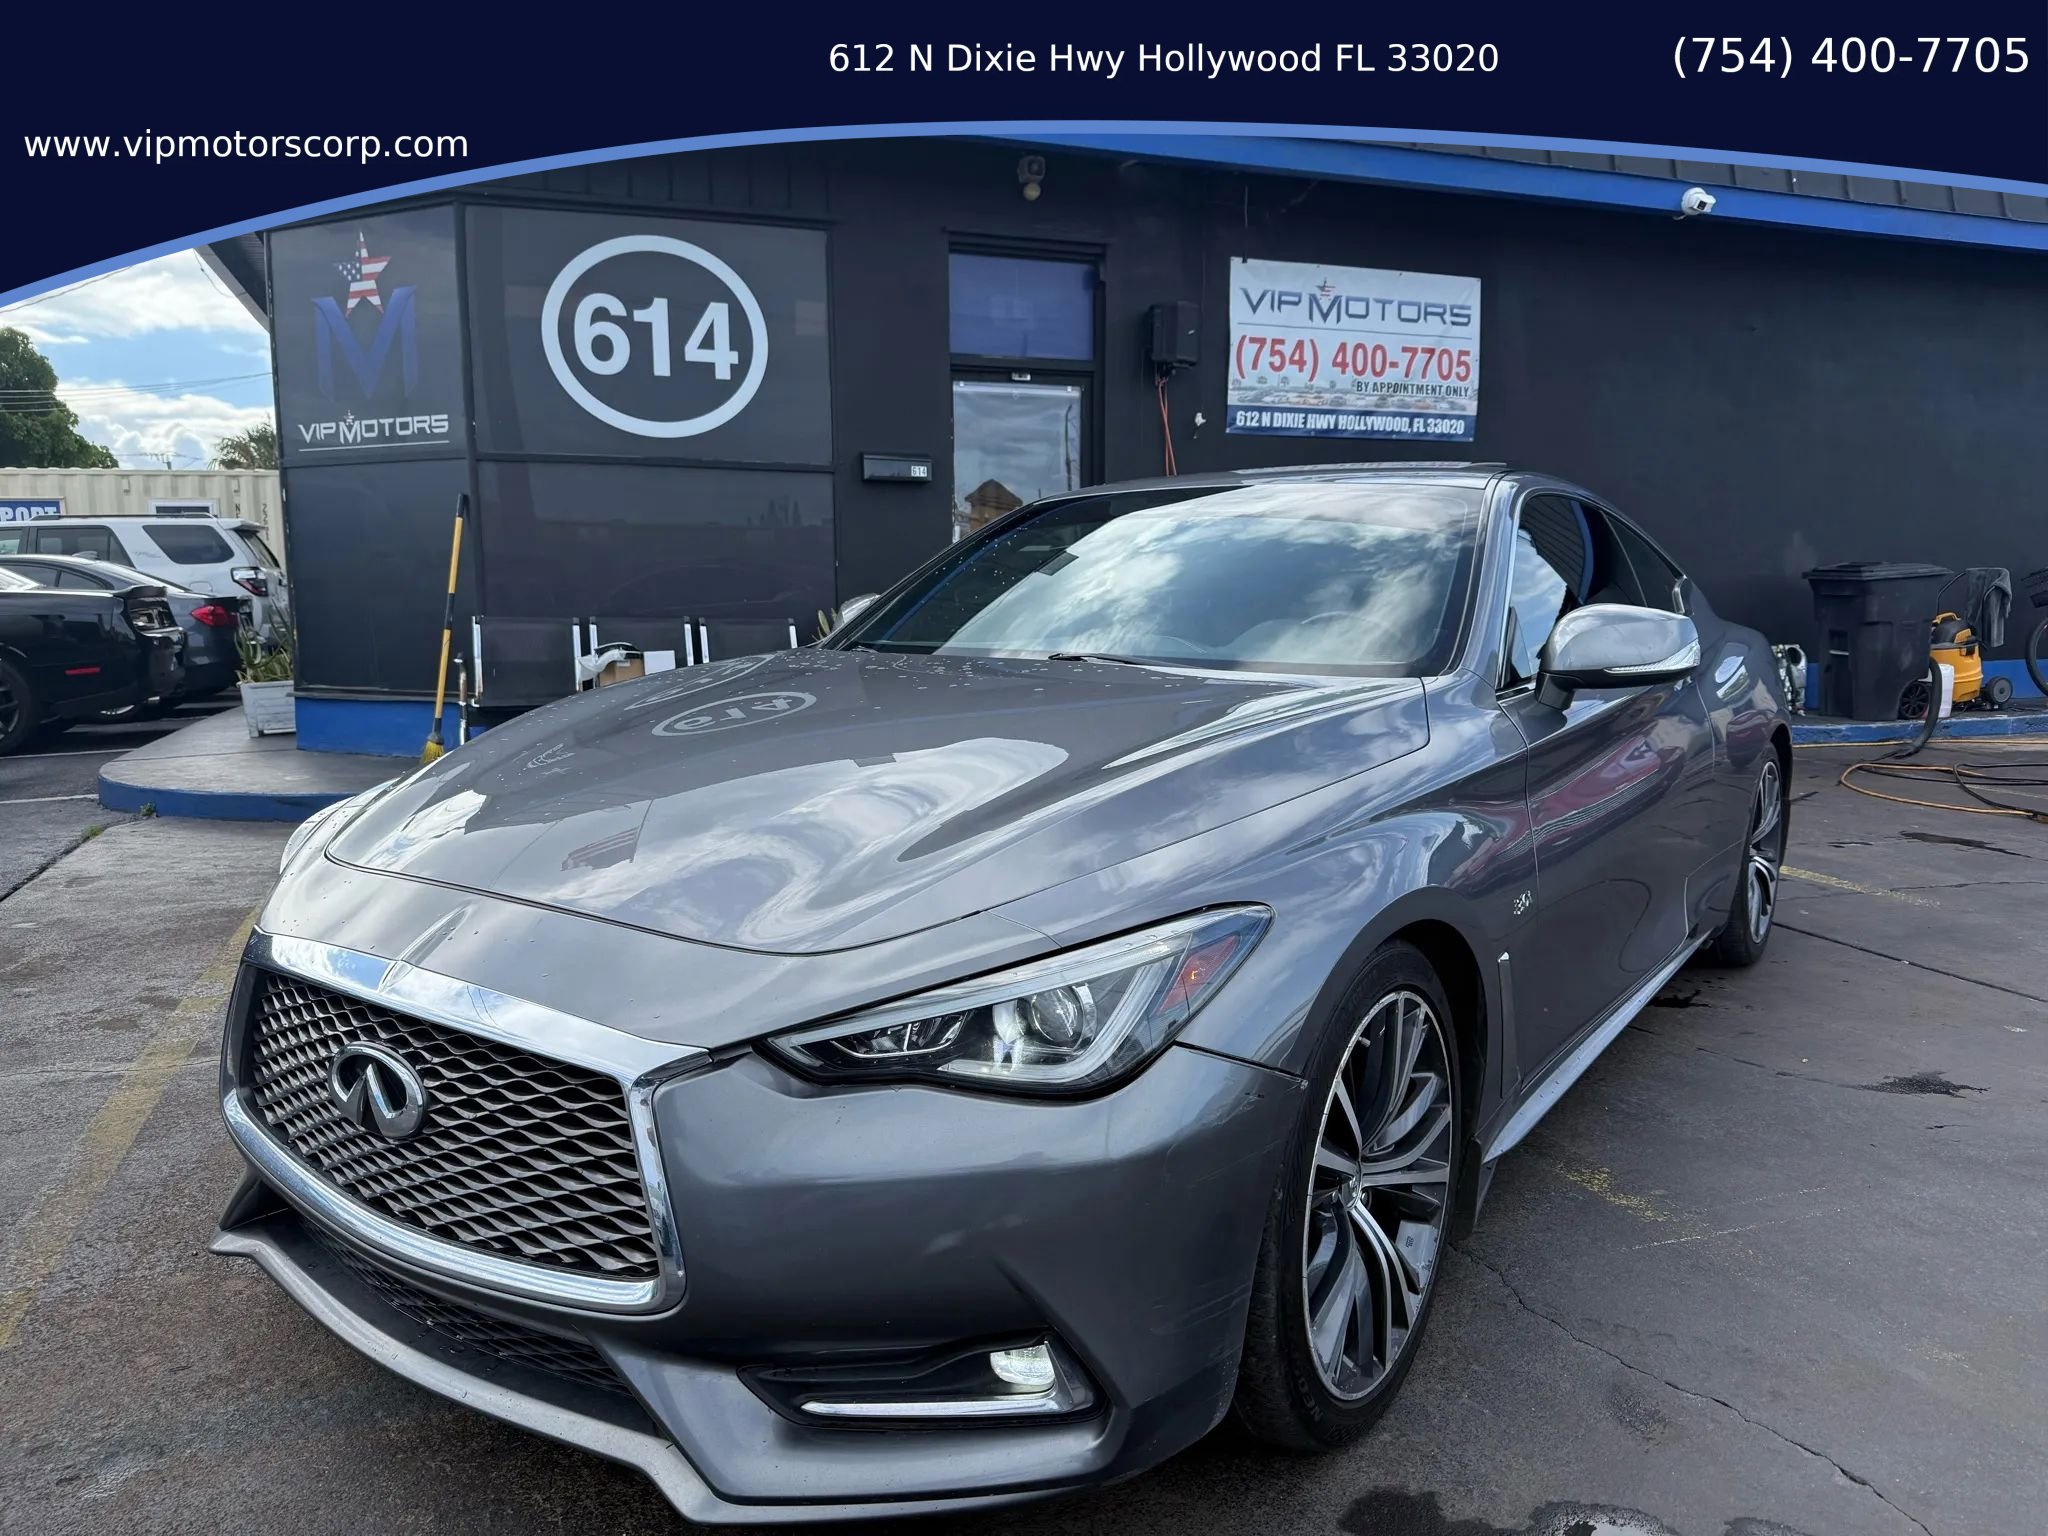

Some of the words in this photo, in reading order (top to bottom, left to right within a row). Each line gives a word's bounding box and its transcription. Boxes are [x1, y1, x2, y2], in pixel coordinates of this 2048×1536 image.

[1239, 287, 1303, 315] VIP
[1307, 293, 1473, 327] MOTORS
[573, 292, 740, 380] 614
[1235, 335, 1320, 382] (754)
[1331, 342, 1472, 382] 400-7705
[1356, 381, 1371, 393] BY
[1372, 382, 1444, 396] APPOINTMENT
[1445, 385, 1470, 398] ONLY
[1235, 410, 1260, 427] 612
[1261, 411, 1272, 427] N
[1272, 412, 1306, 429] DIXIE
[1306, 413, 1337, 430] HWY
[1338, 415, 1412, 433] HOLLYWOOD,
[1413, 418, 1426, 432] FL
[1427, 419, 1465, 435] 33020
